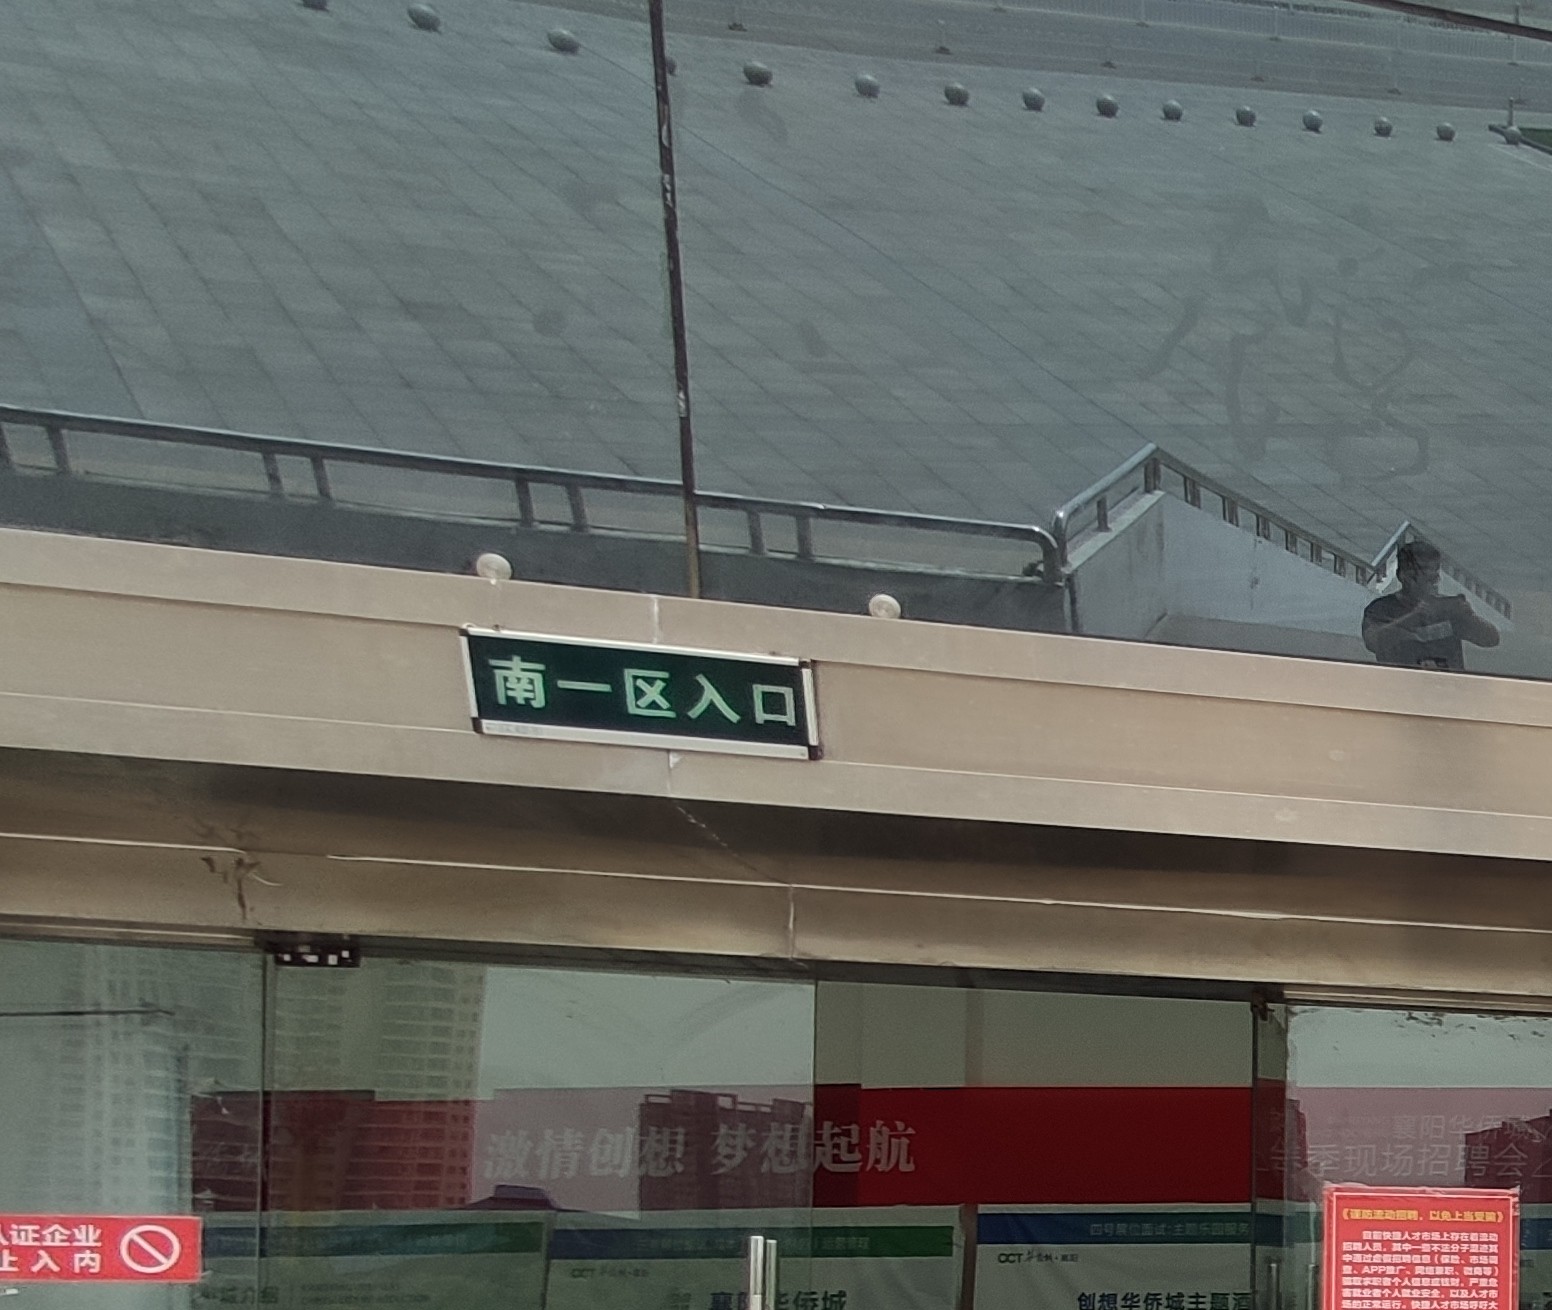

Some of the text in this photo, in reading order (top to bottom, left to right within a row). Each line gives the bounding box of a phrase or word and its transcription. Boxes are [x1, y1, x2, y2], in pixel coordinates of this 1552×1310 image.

[487, 655, 798, 729] 南一区入口
[484, 1120, 917, 1180] 激情创想 梦想起航
